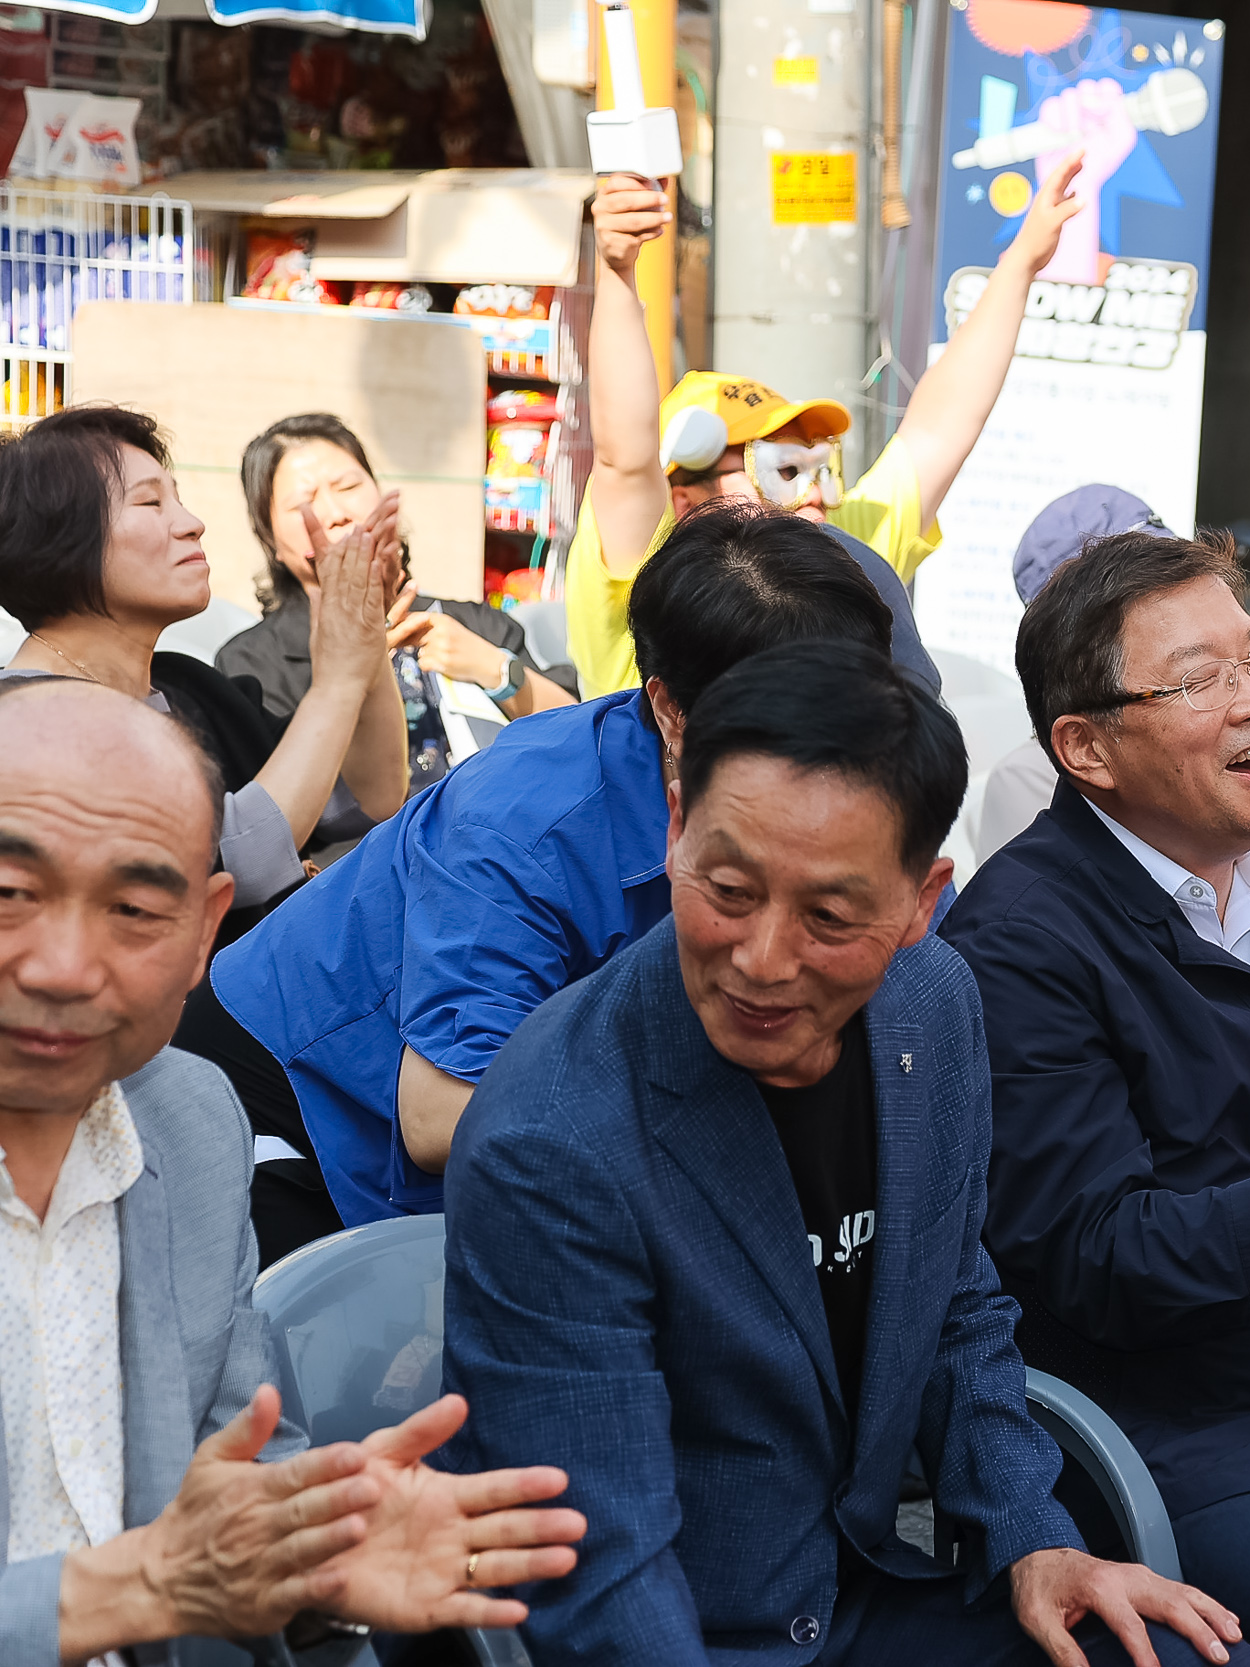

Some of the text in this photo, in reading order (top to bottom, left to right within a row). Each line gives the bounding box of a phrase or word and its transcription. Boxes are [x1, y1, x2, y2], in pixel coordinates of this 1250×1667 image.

[1106, 262, 1191, 296] 2024
[953, 273, 1187, 332] SOW ME
